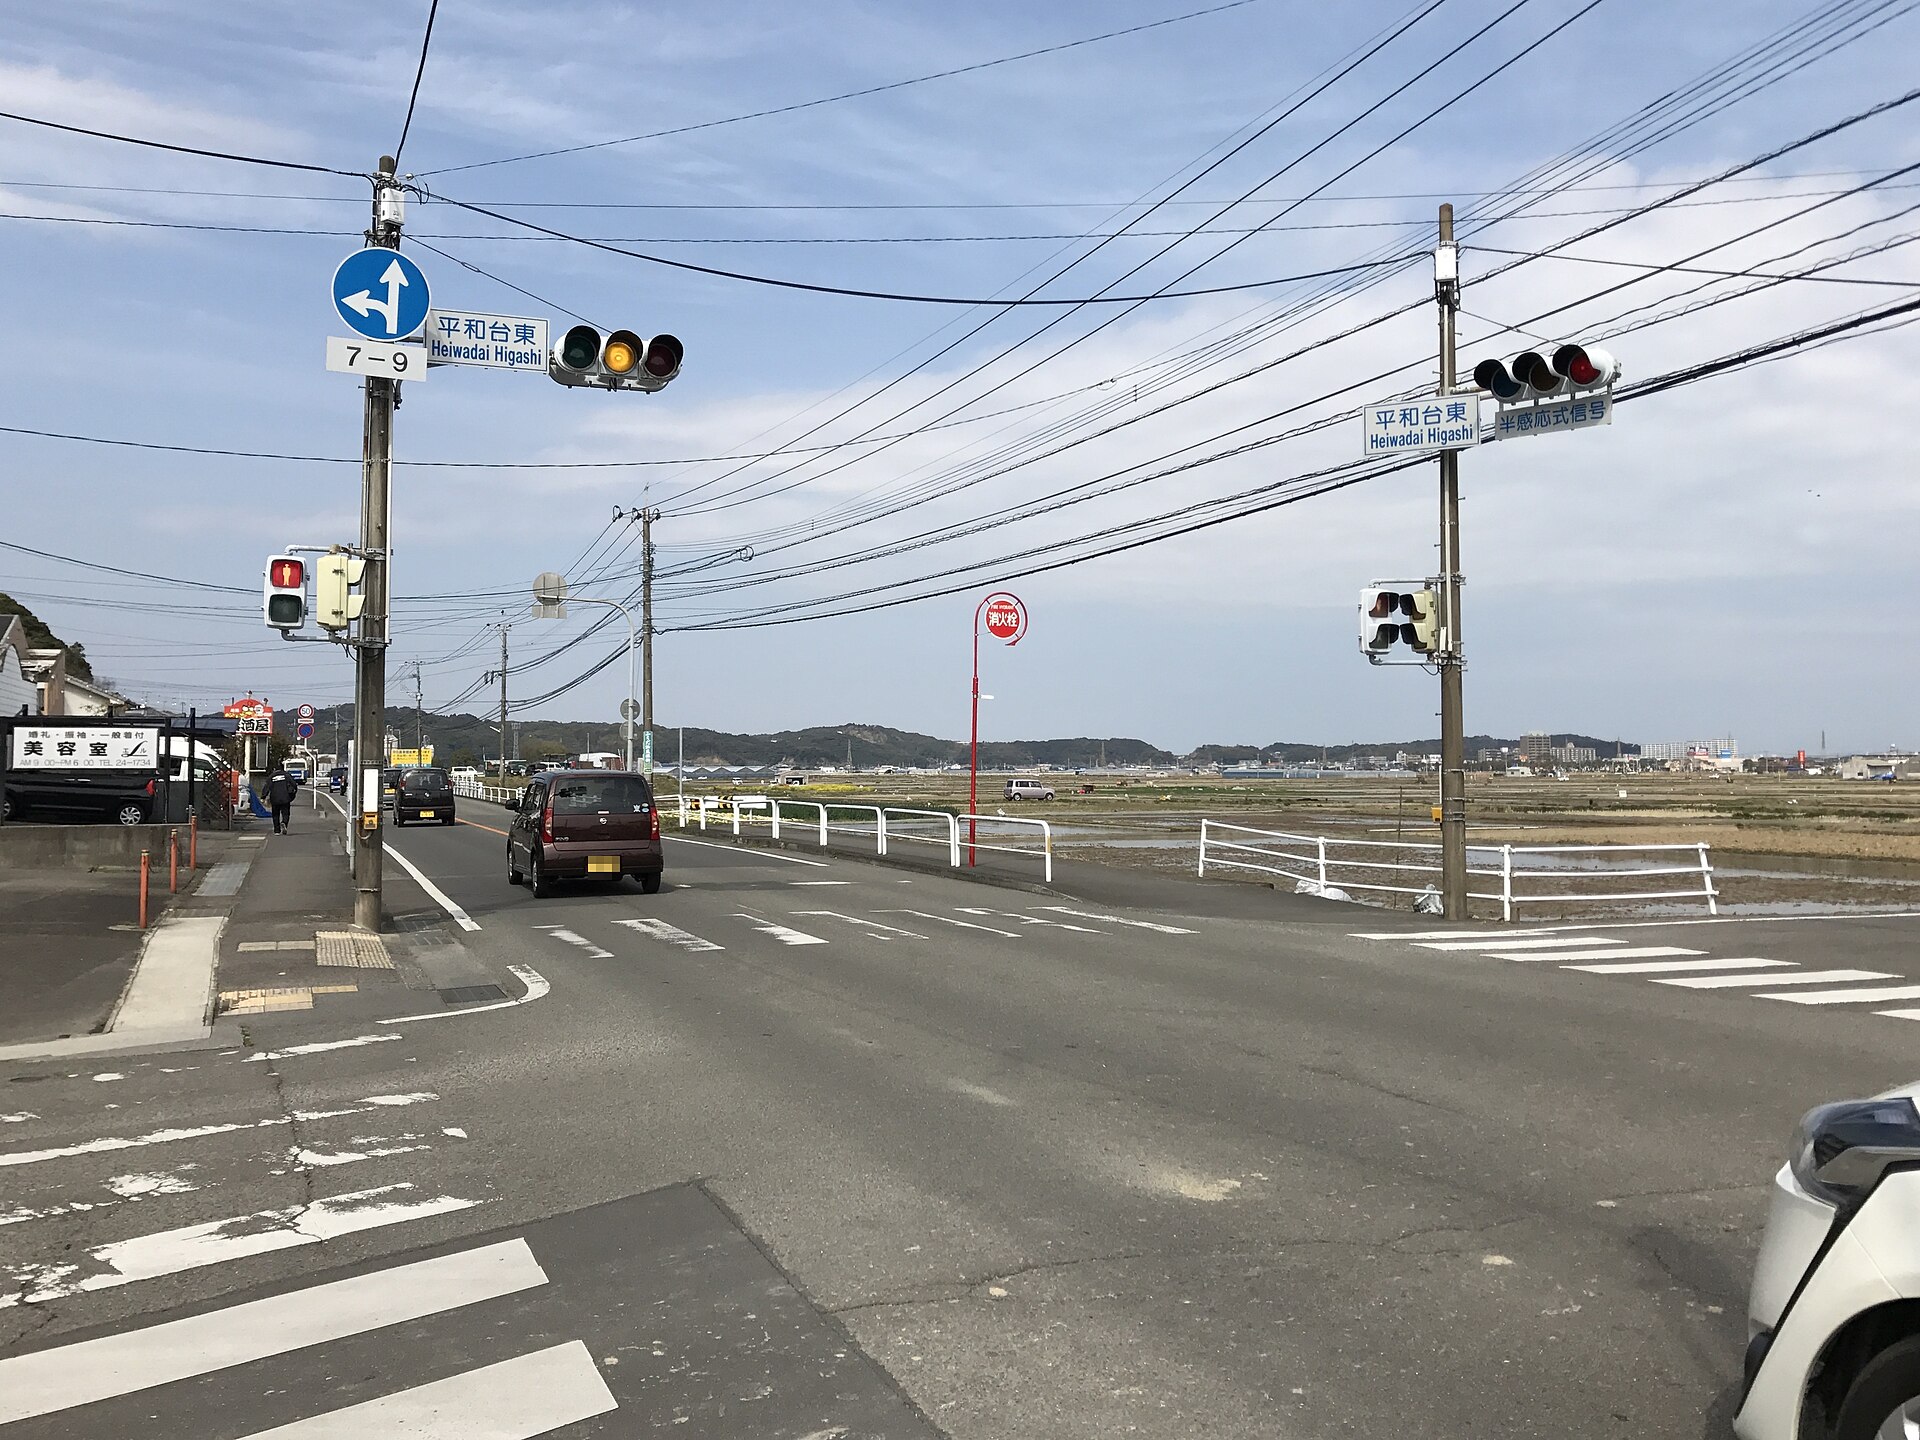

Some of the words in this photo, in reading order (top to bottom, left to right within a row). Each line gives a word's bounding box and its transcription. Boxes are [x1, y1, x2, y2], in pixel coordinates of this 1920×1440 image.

[438, 316, 536, 346] 平和台東
[431, 339, 490, 361] Heiwadai
[494, 345, 542, 366] Higashi
[1375, 402, 1468, 430] 平和台東
[1500, 400, 1606, 433] 半感応式信号
[1370, 429, 1424, 449] Heiwadai
[1428, 424, 1473, 444] Higashi
[988, 611, 1018, 627] 消火栓
[23, 741, 108, 757] 美容室
